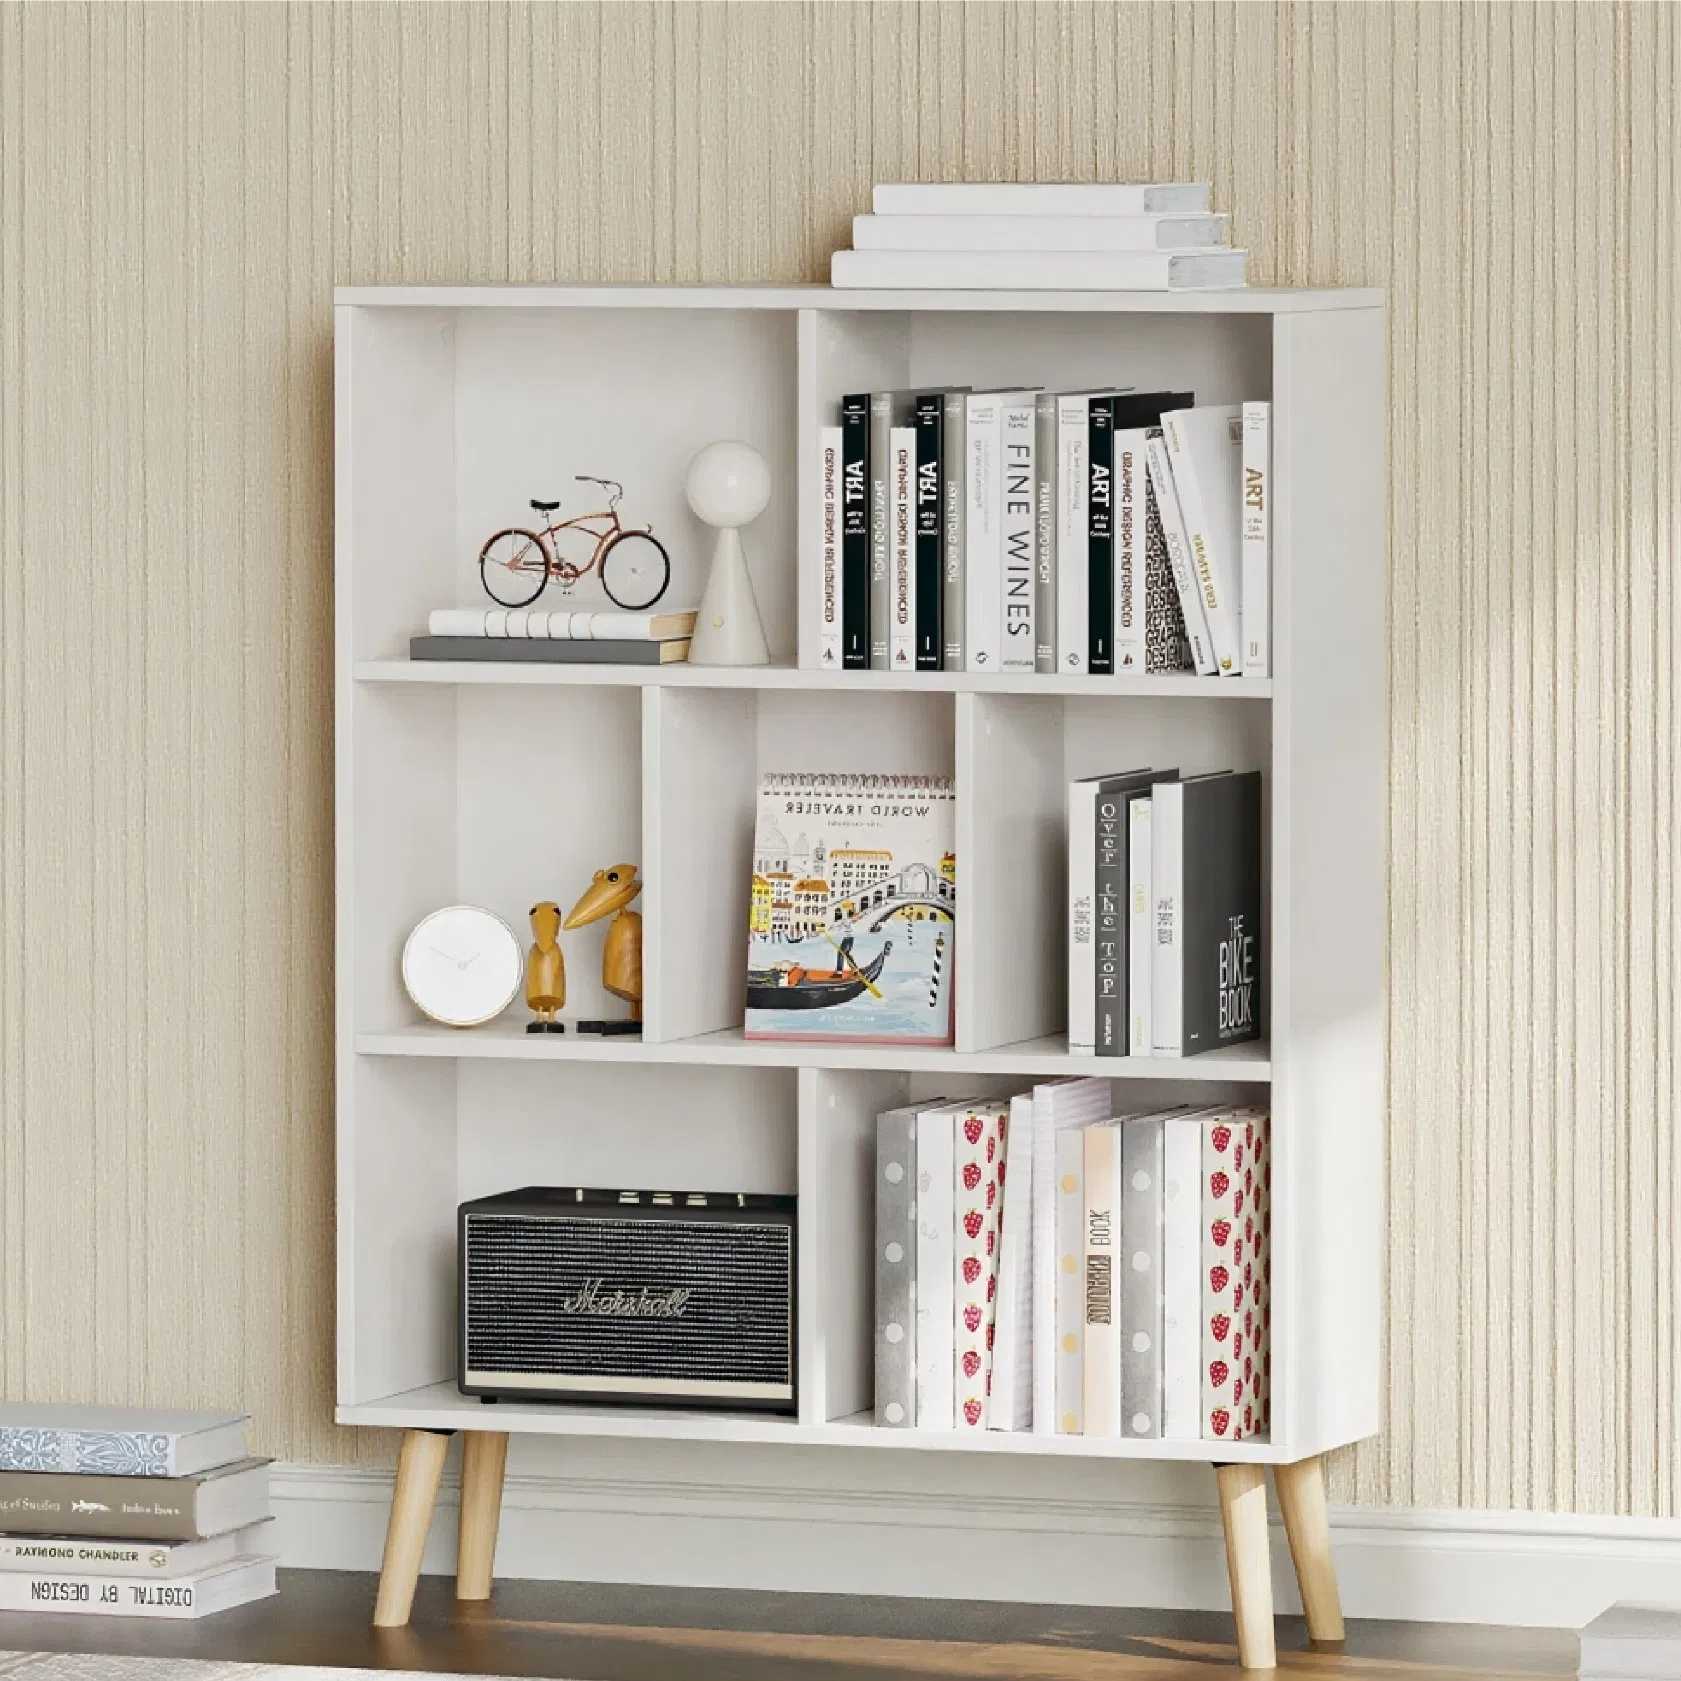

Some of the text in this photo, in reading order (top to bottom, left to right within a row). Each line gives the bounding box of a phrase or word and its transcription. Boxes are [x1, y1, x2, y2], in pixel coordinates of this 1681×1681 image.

[1006, 444, 1031, 515] FINE
[1091, 463, 1110, 508] ART
[1245, 467, 1264, 511] ART
[1006, 530, 1031, 637] WINES
[1100, 803, 1117, 863] Over
[1228, 914, 1244, 938] THE
[1219, 936, 1254, 988] BIKE
[1219, 984, 1252, 1031] BOOK
[15, 1546, 139, 1562] RAYMOND CHANDLER
[31, 1580, 193, 1607] DIGITAL BY DESIGN
